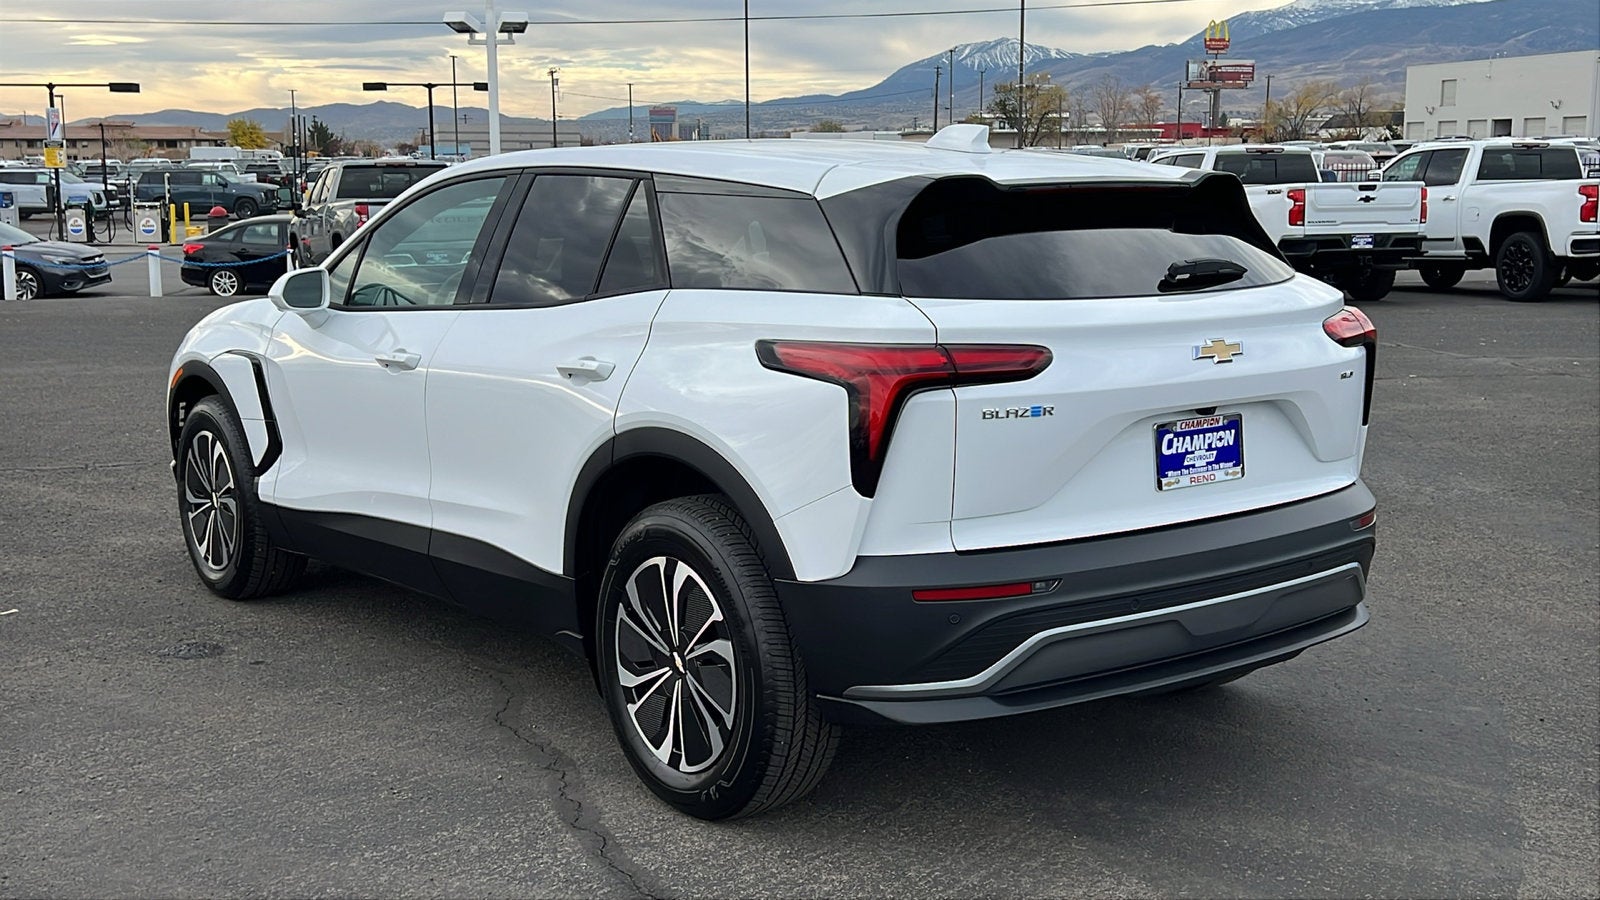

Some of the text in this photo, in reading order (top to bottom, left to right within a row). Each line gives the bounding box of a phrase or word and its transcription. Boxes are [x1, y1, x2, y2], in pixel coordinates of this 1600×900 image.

[982, 405, 1055, 420] BLAZER
[1180, 417, 1221, 430] CHAMPION
[1161, 429, 1236, 456] CHAMPION
[1186, 452, 1215, 463] CHEVROLET
[1189, 473, 1216, 484] RENO
